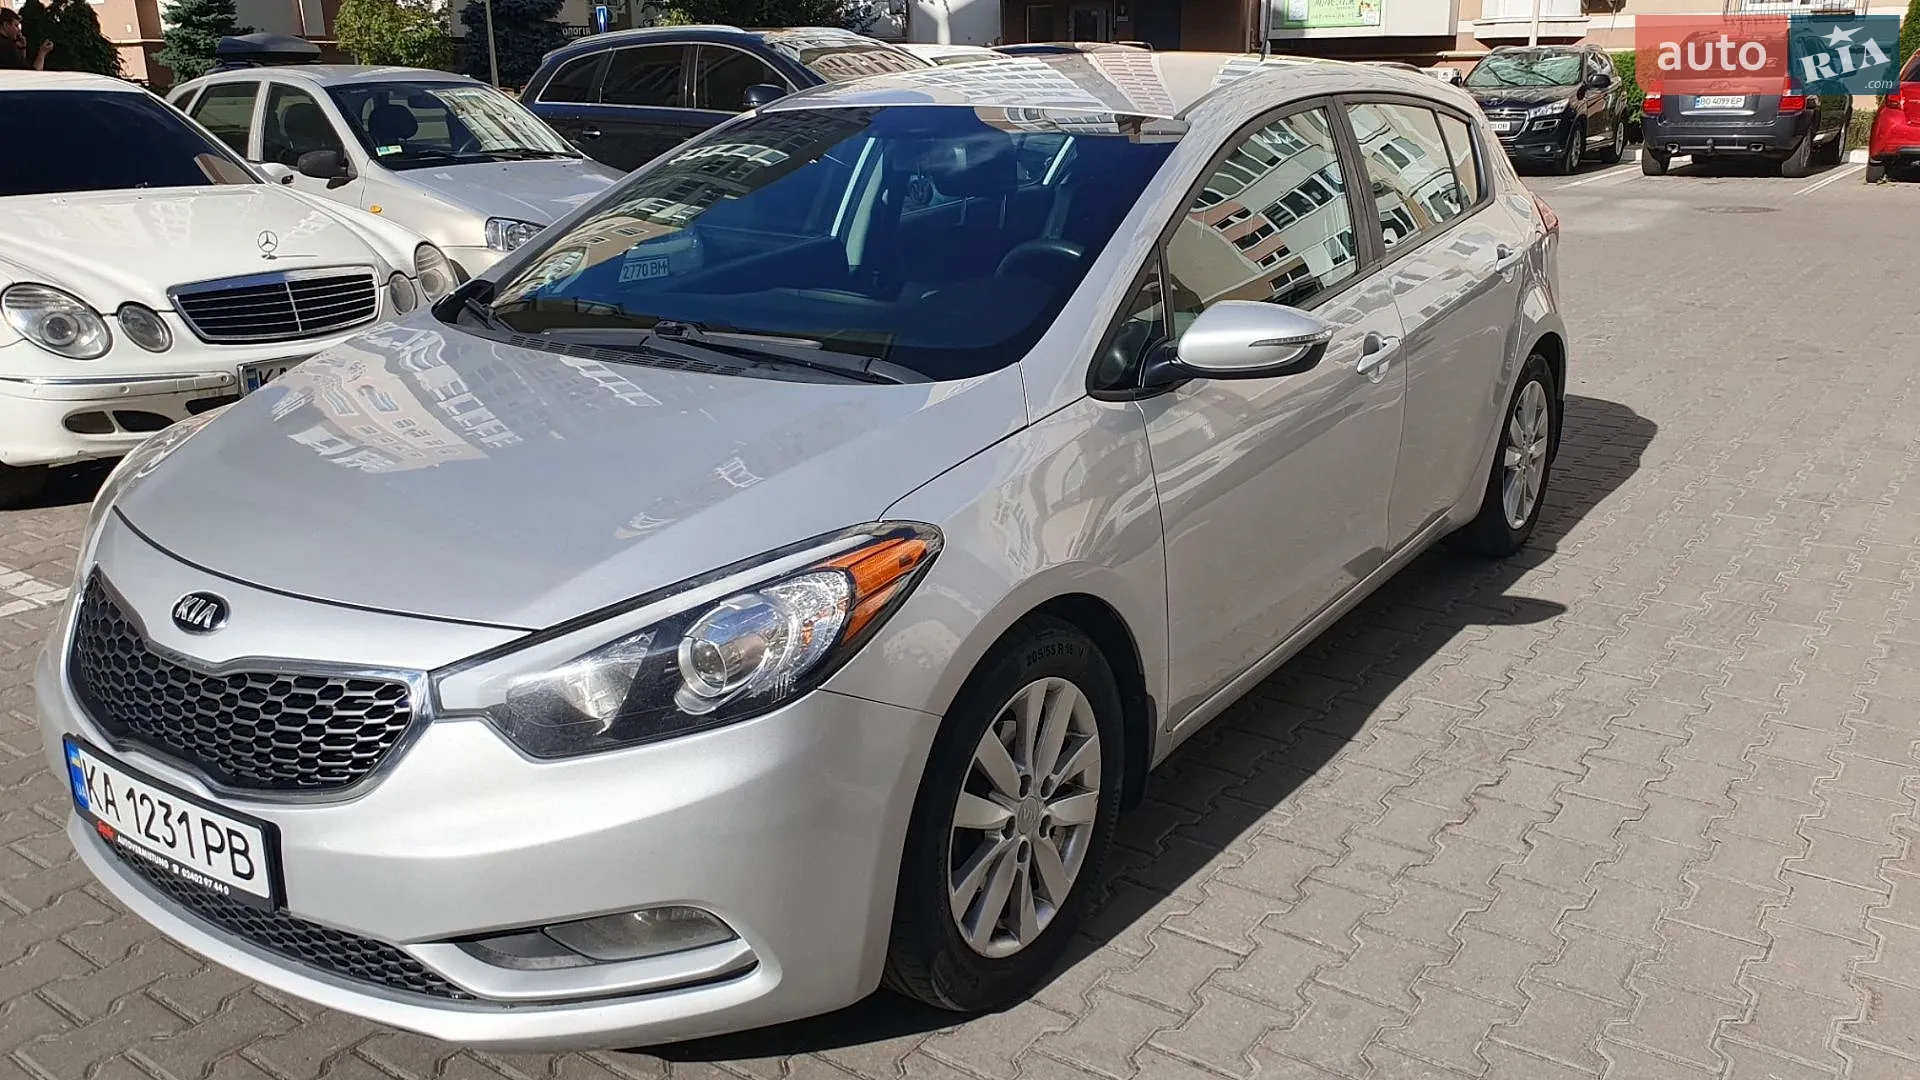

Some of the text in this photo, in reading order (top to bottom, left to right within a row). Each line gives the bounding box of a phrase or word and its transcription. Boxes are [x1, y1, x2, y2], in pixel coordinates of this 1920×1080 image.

[623, 264, 649, 279] 2770
[175, 595, 218, 629] KIA
[82, 759, 255, 881] KA 1231 PB
